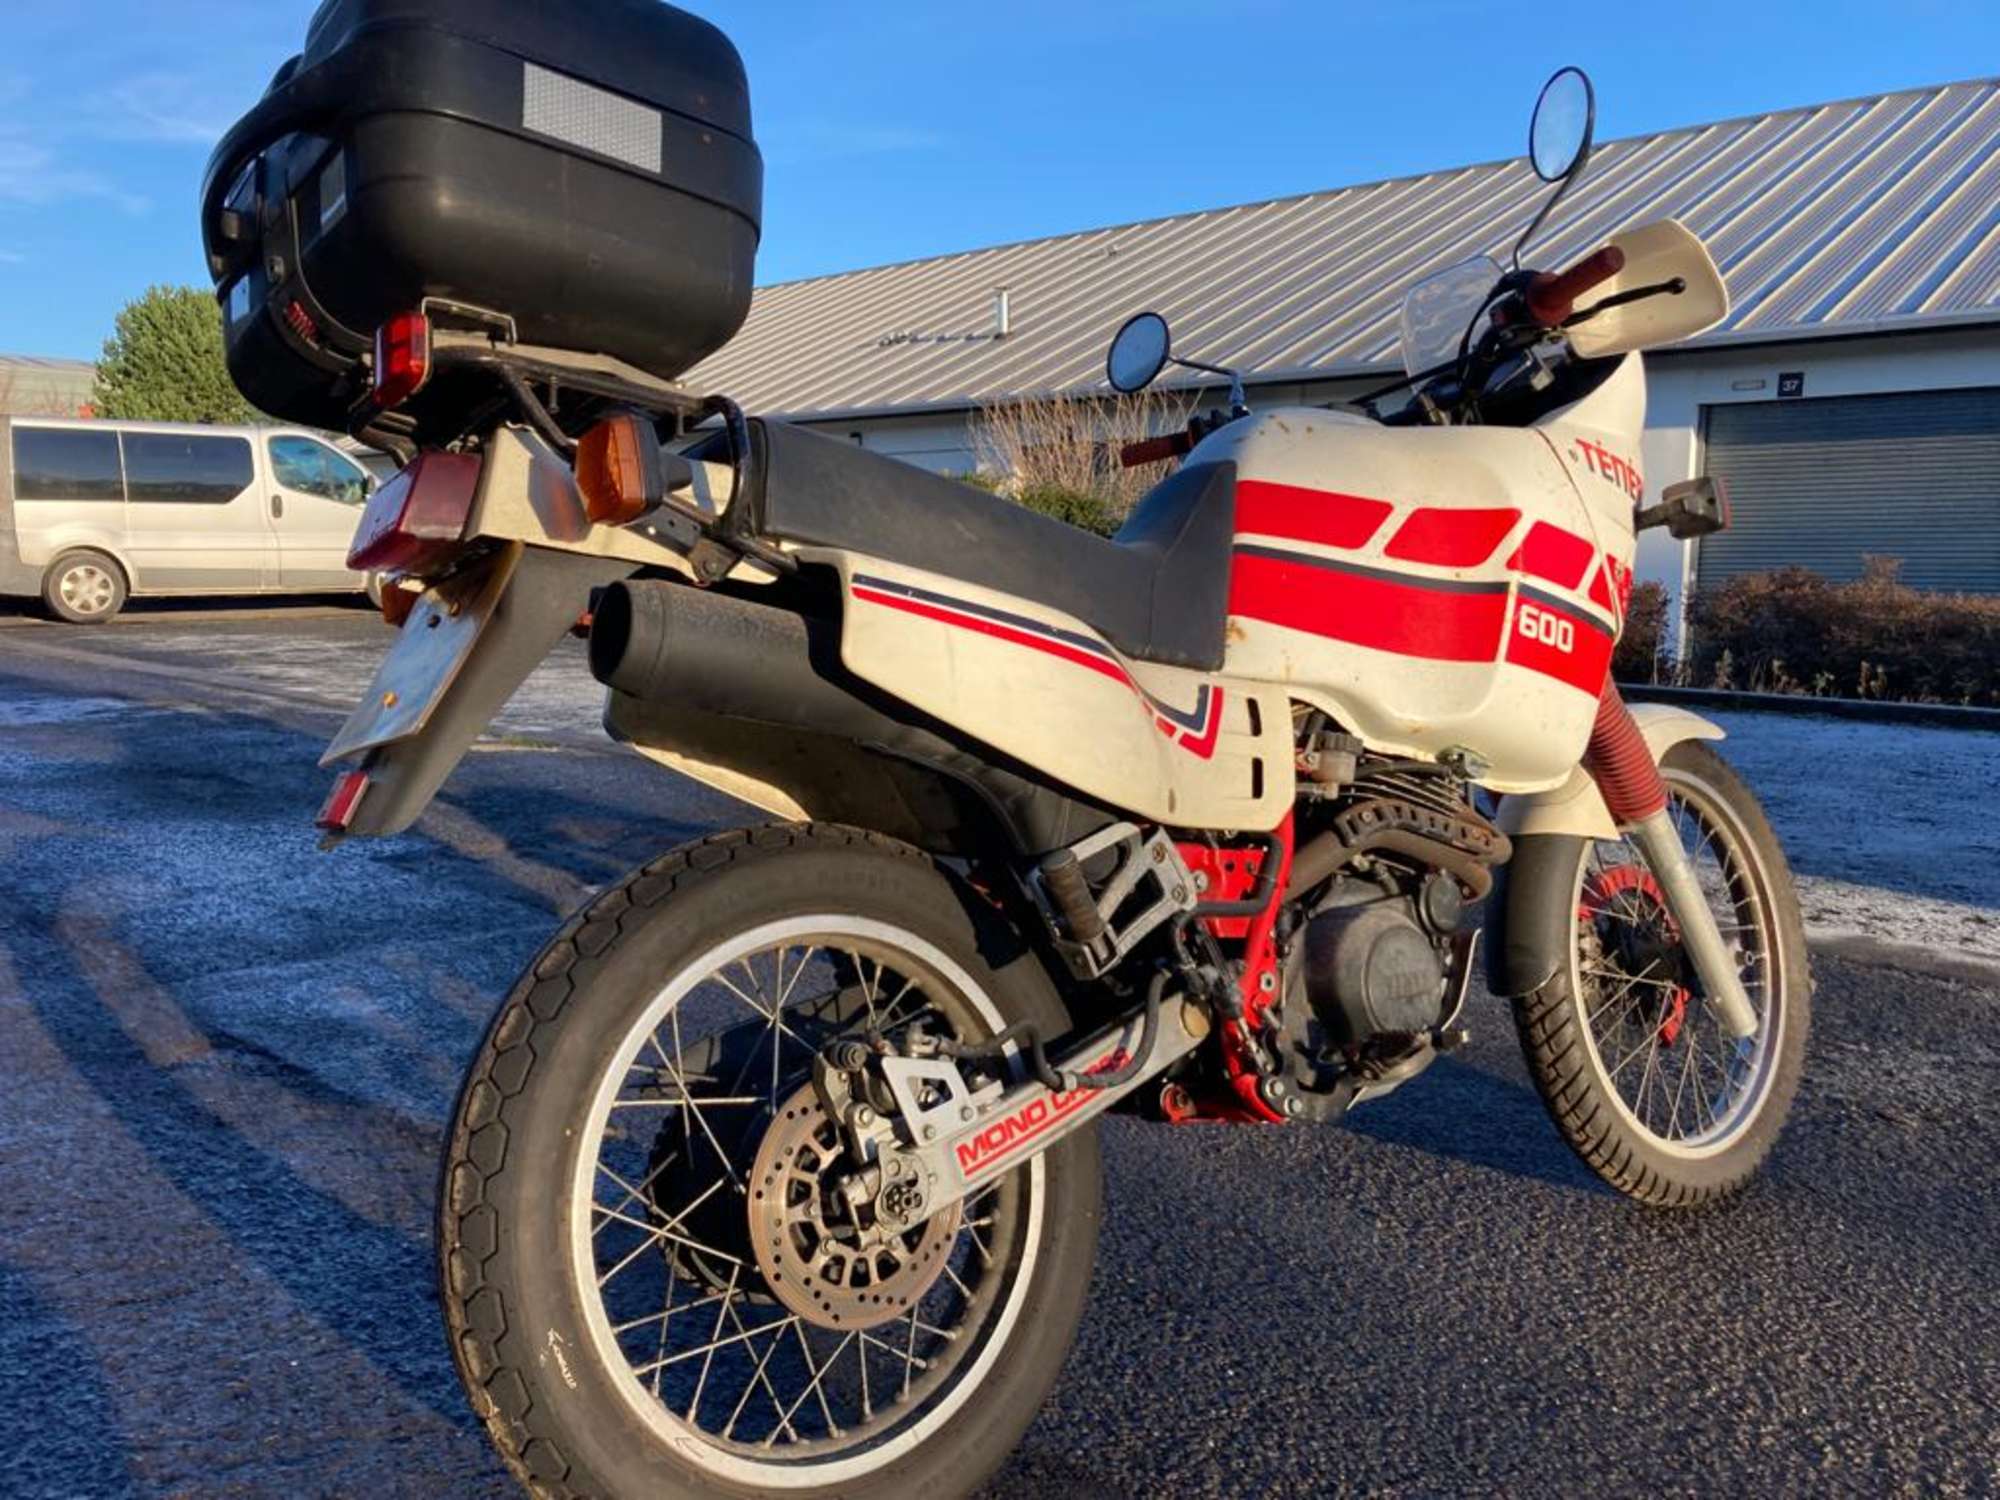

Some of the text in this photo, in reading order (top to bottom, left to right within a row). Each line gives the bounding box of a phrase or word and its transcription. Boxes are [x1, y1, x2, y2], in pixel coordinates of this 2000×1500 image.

[1782, 379, 1799, 392] 37
[1575, 438, 1643, 501] TÉNÉ
[1519, 603, 1574, 654] 600
[956, 1098, 1047, 1167] MONO
